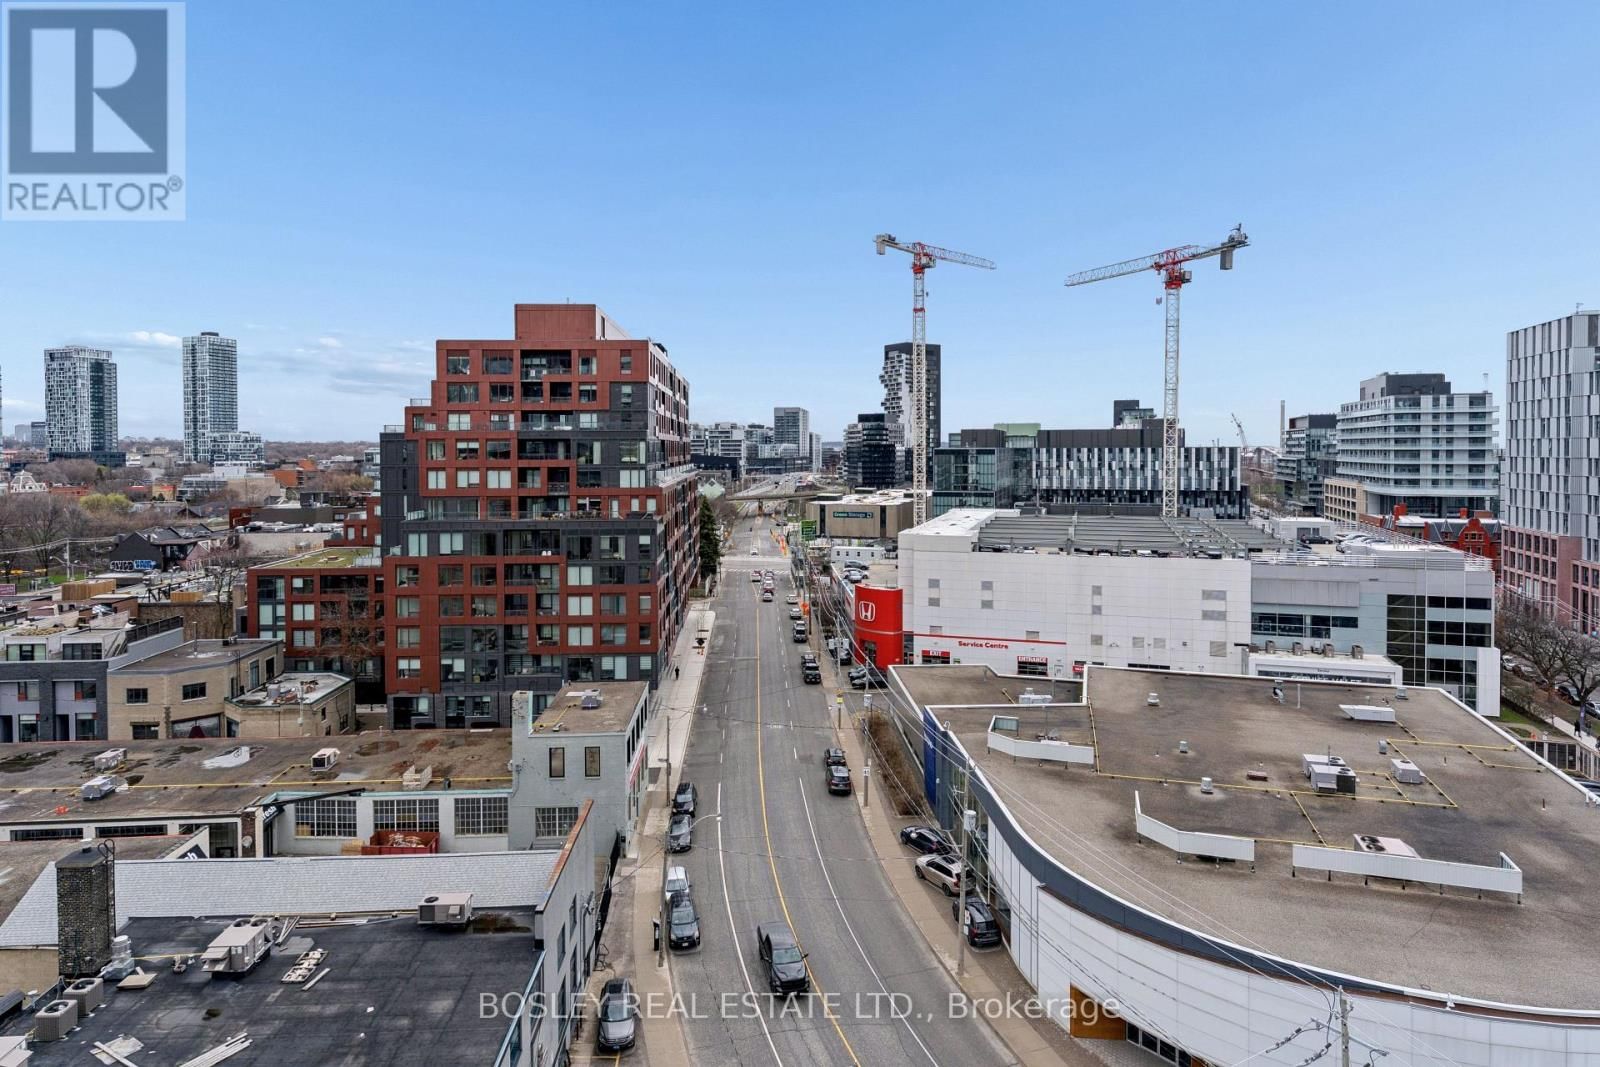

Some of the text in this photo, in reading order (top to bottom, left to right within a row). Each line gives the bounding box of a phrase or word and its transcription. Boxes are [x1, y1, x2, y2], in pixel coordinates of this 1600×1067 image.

[958, 640, 1008, 650] Service Centre
[1018, 656, 1047, 664] ENTRANCE
